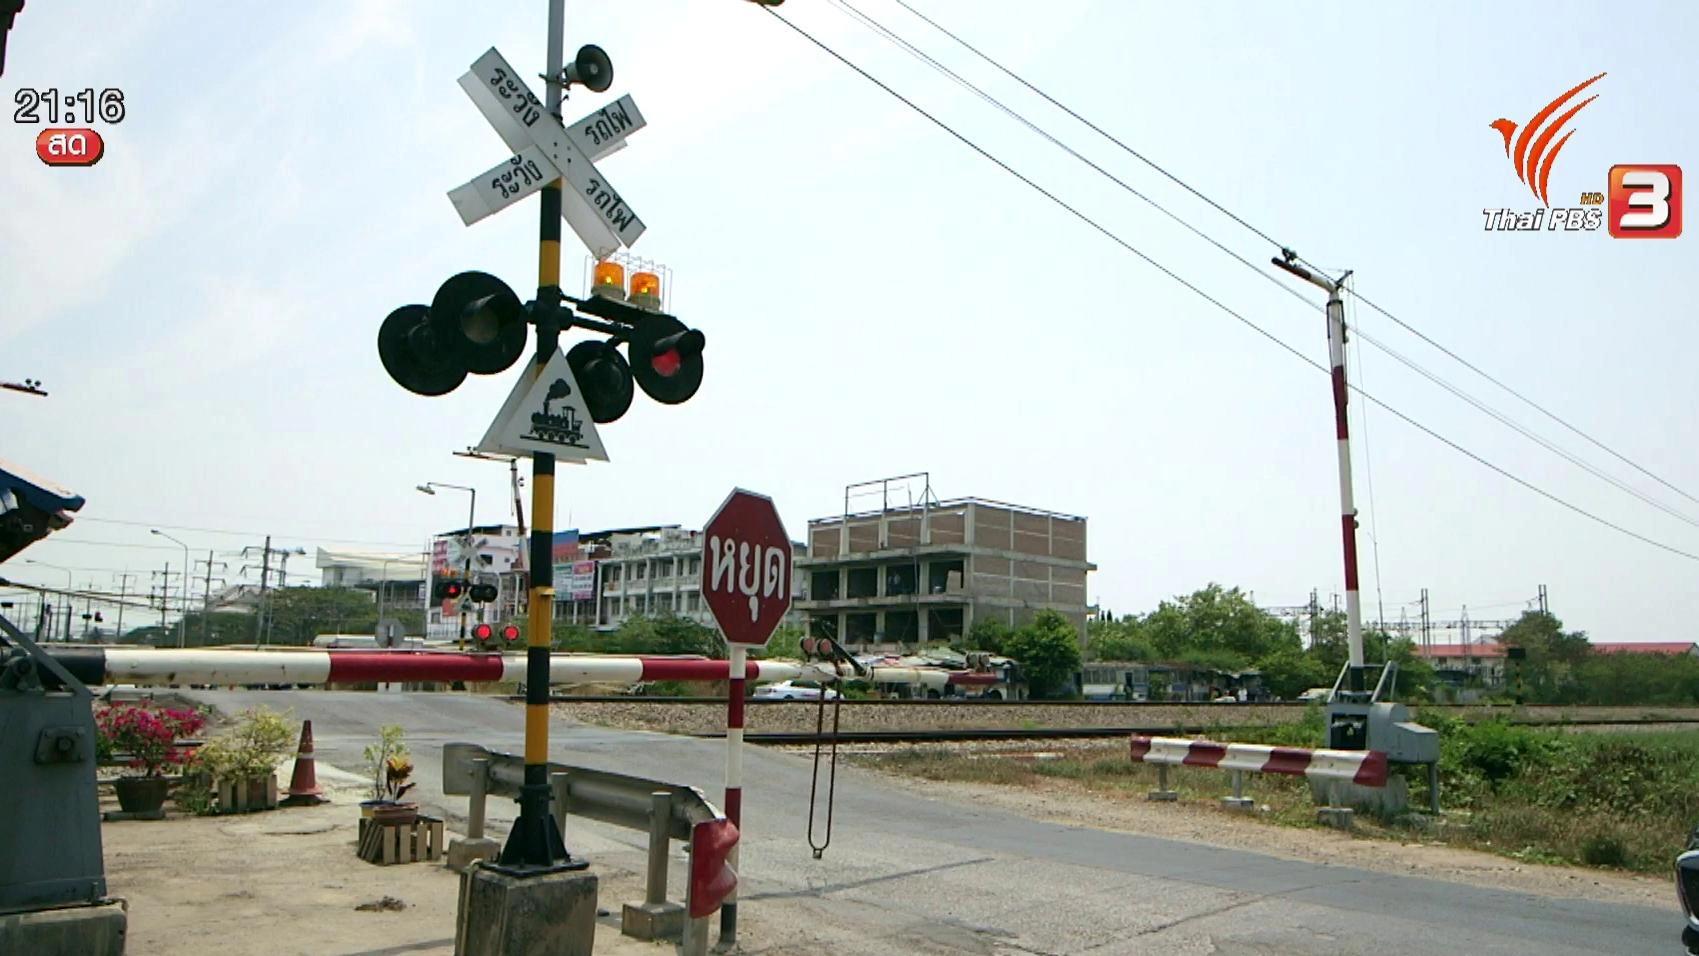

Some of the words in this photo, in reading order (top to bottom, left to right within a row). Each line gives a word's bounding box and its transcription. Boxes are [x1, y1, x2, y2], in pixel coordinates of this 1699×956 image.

[490, 67, 541, 128] ระวัง
[586, 178, 635, 233] รถไฟ
[492, 154, 544, 199] ระวัง
[585, 100, 633, 145] รถไฟ
[709, 535, 786, 623] หยุด
